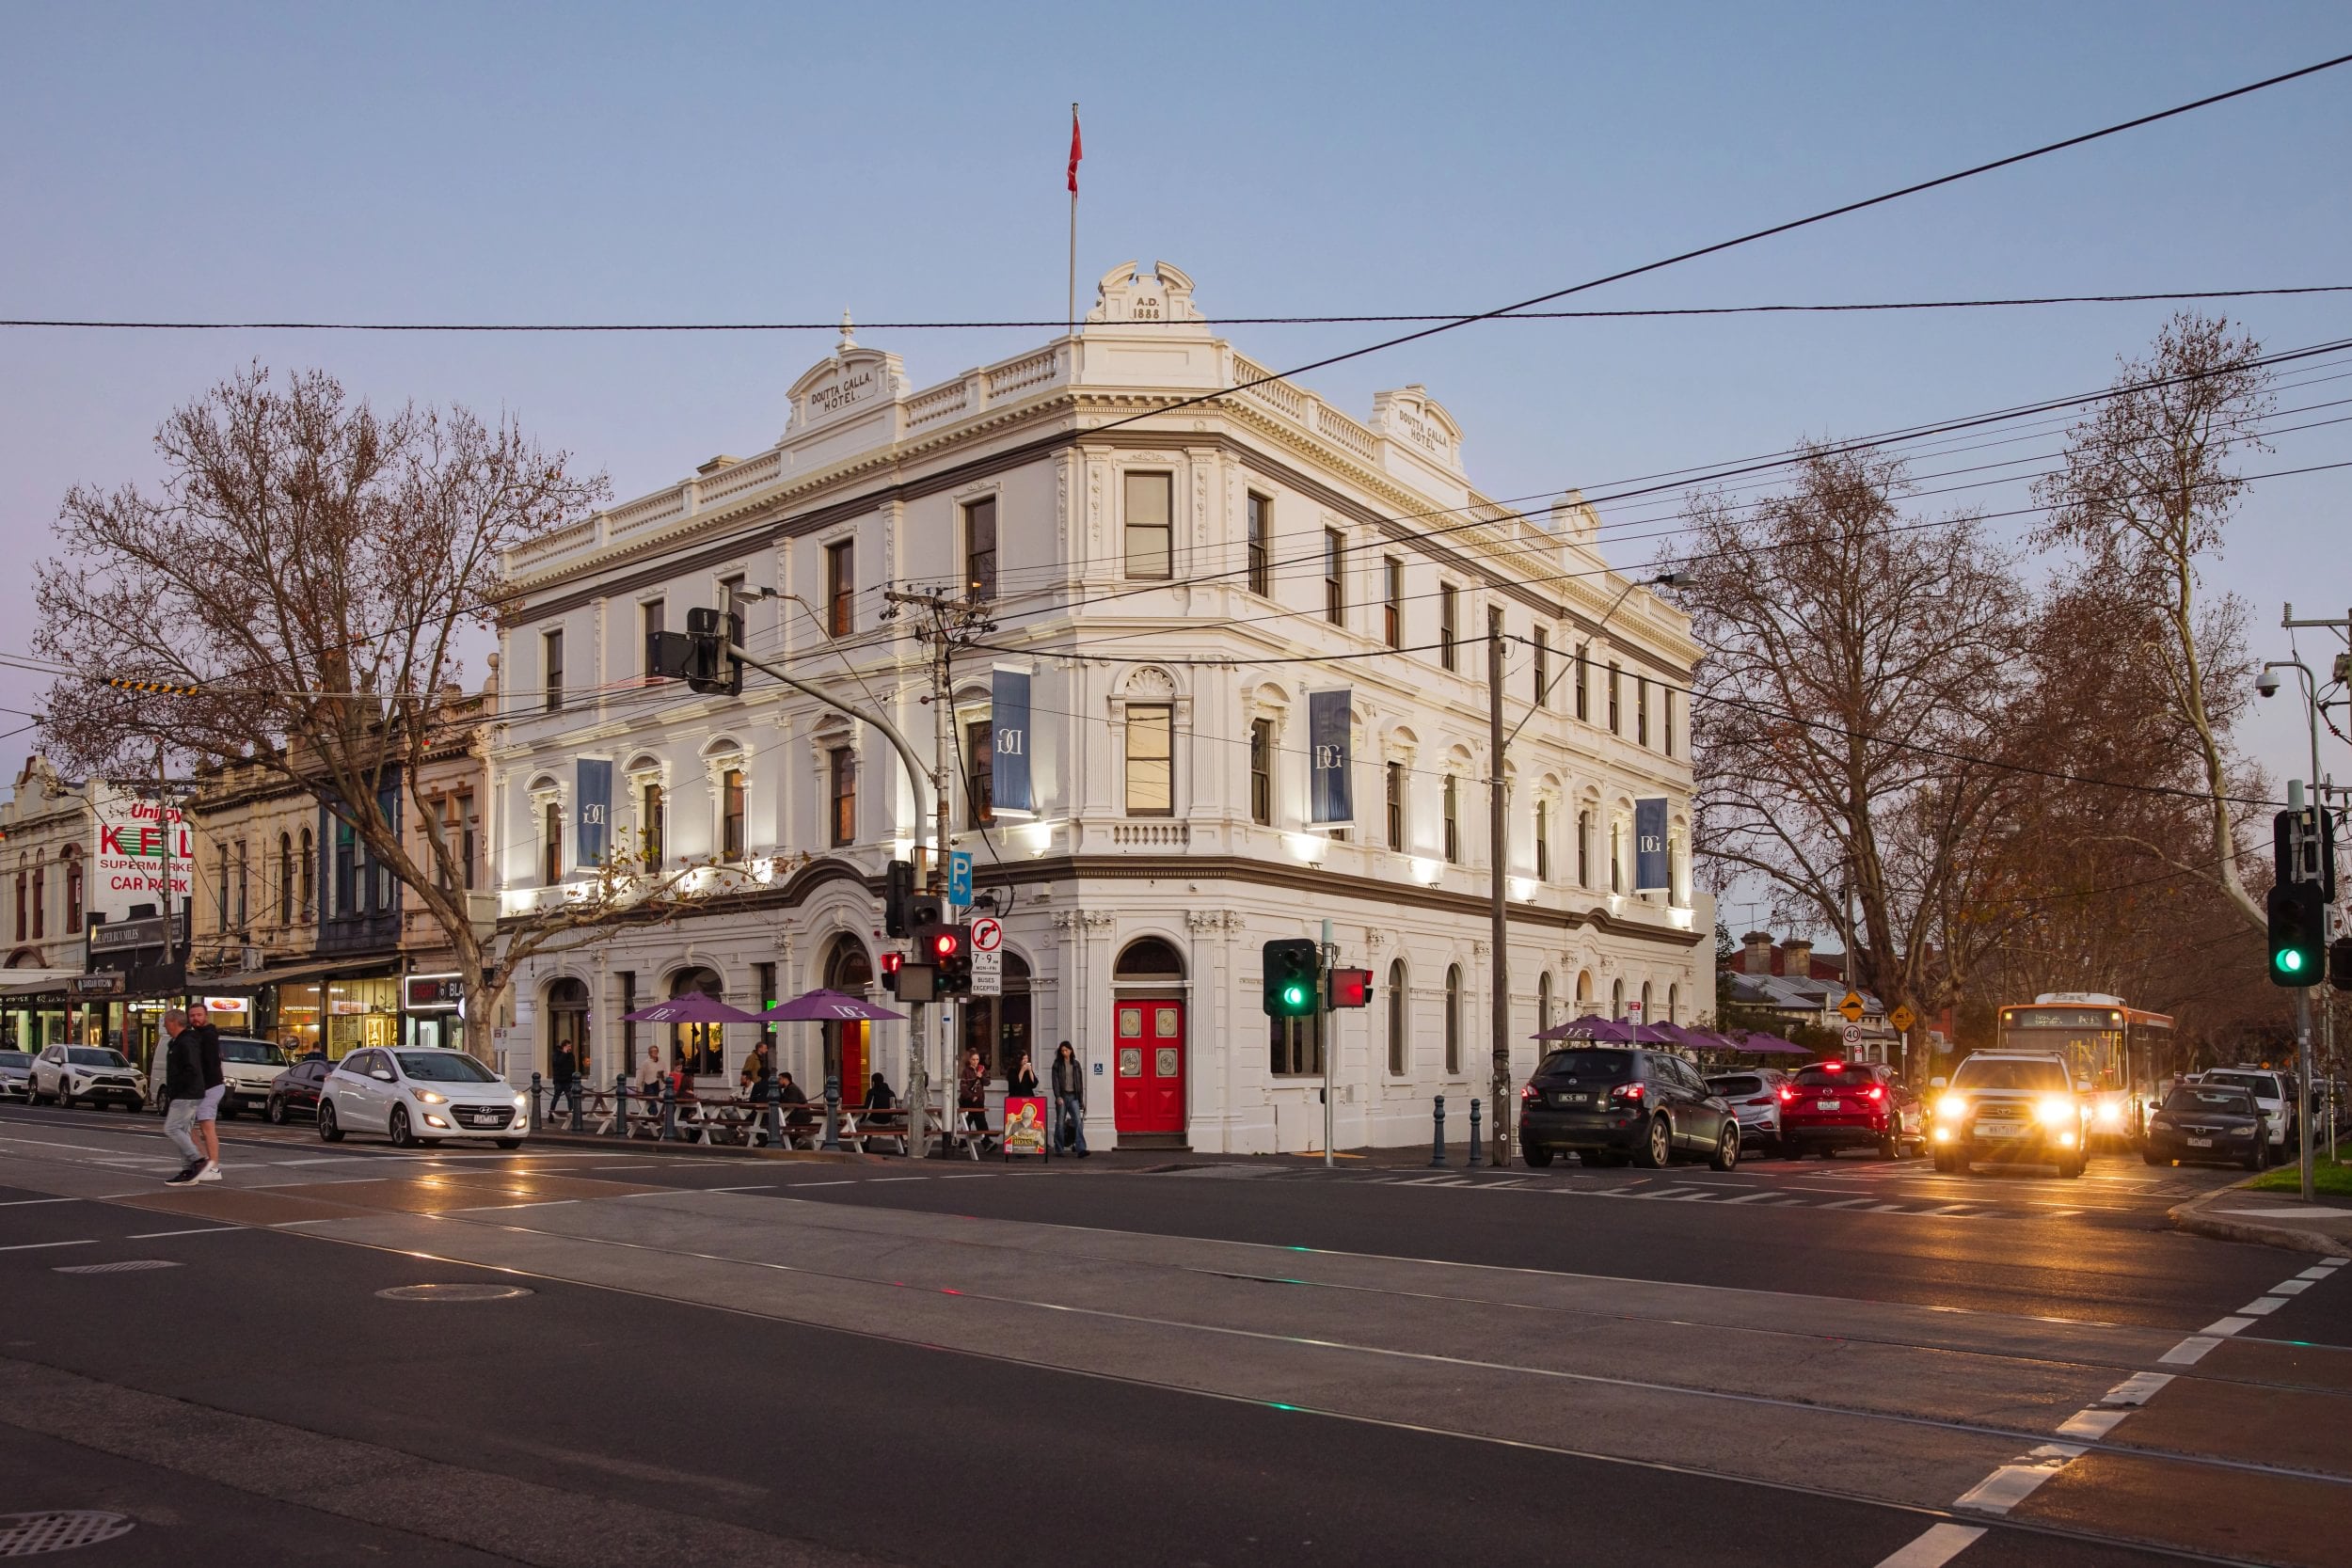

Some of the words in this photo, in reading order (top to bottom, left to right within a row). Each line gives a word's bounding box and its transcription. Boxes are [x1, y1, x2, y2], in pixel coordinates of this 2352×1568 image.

[1136, 297, 1159, 307] A.D.
[1134, 309, 1159, 319] 1888
[812, 385, 840, 405] DOUTTA
[1399, 409, 1424, 434] DOUTTA
[1410, 428, 1436, 451] HOTEL
[1315, 744, 1343, 769] DG
[1640, 835, 1661, 853] DG
[100, 859, 193, 873] SUPERMARKE
[953, 858, 969, 884] P
[111, 876, 143, 891] CAR
[148, 878, 188, 893] PARK
[449, 983, 465, 997] BLA
[1846, 1030, 1859, 1039] 40
